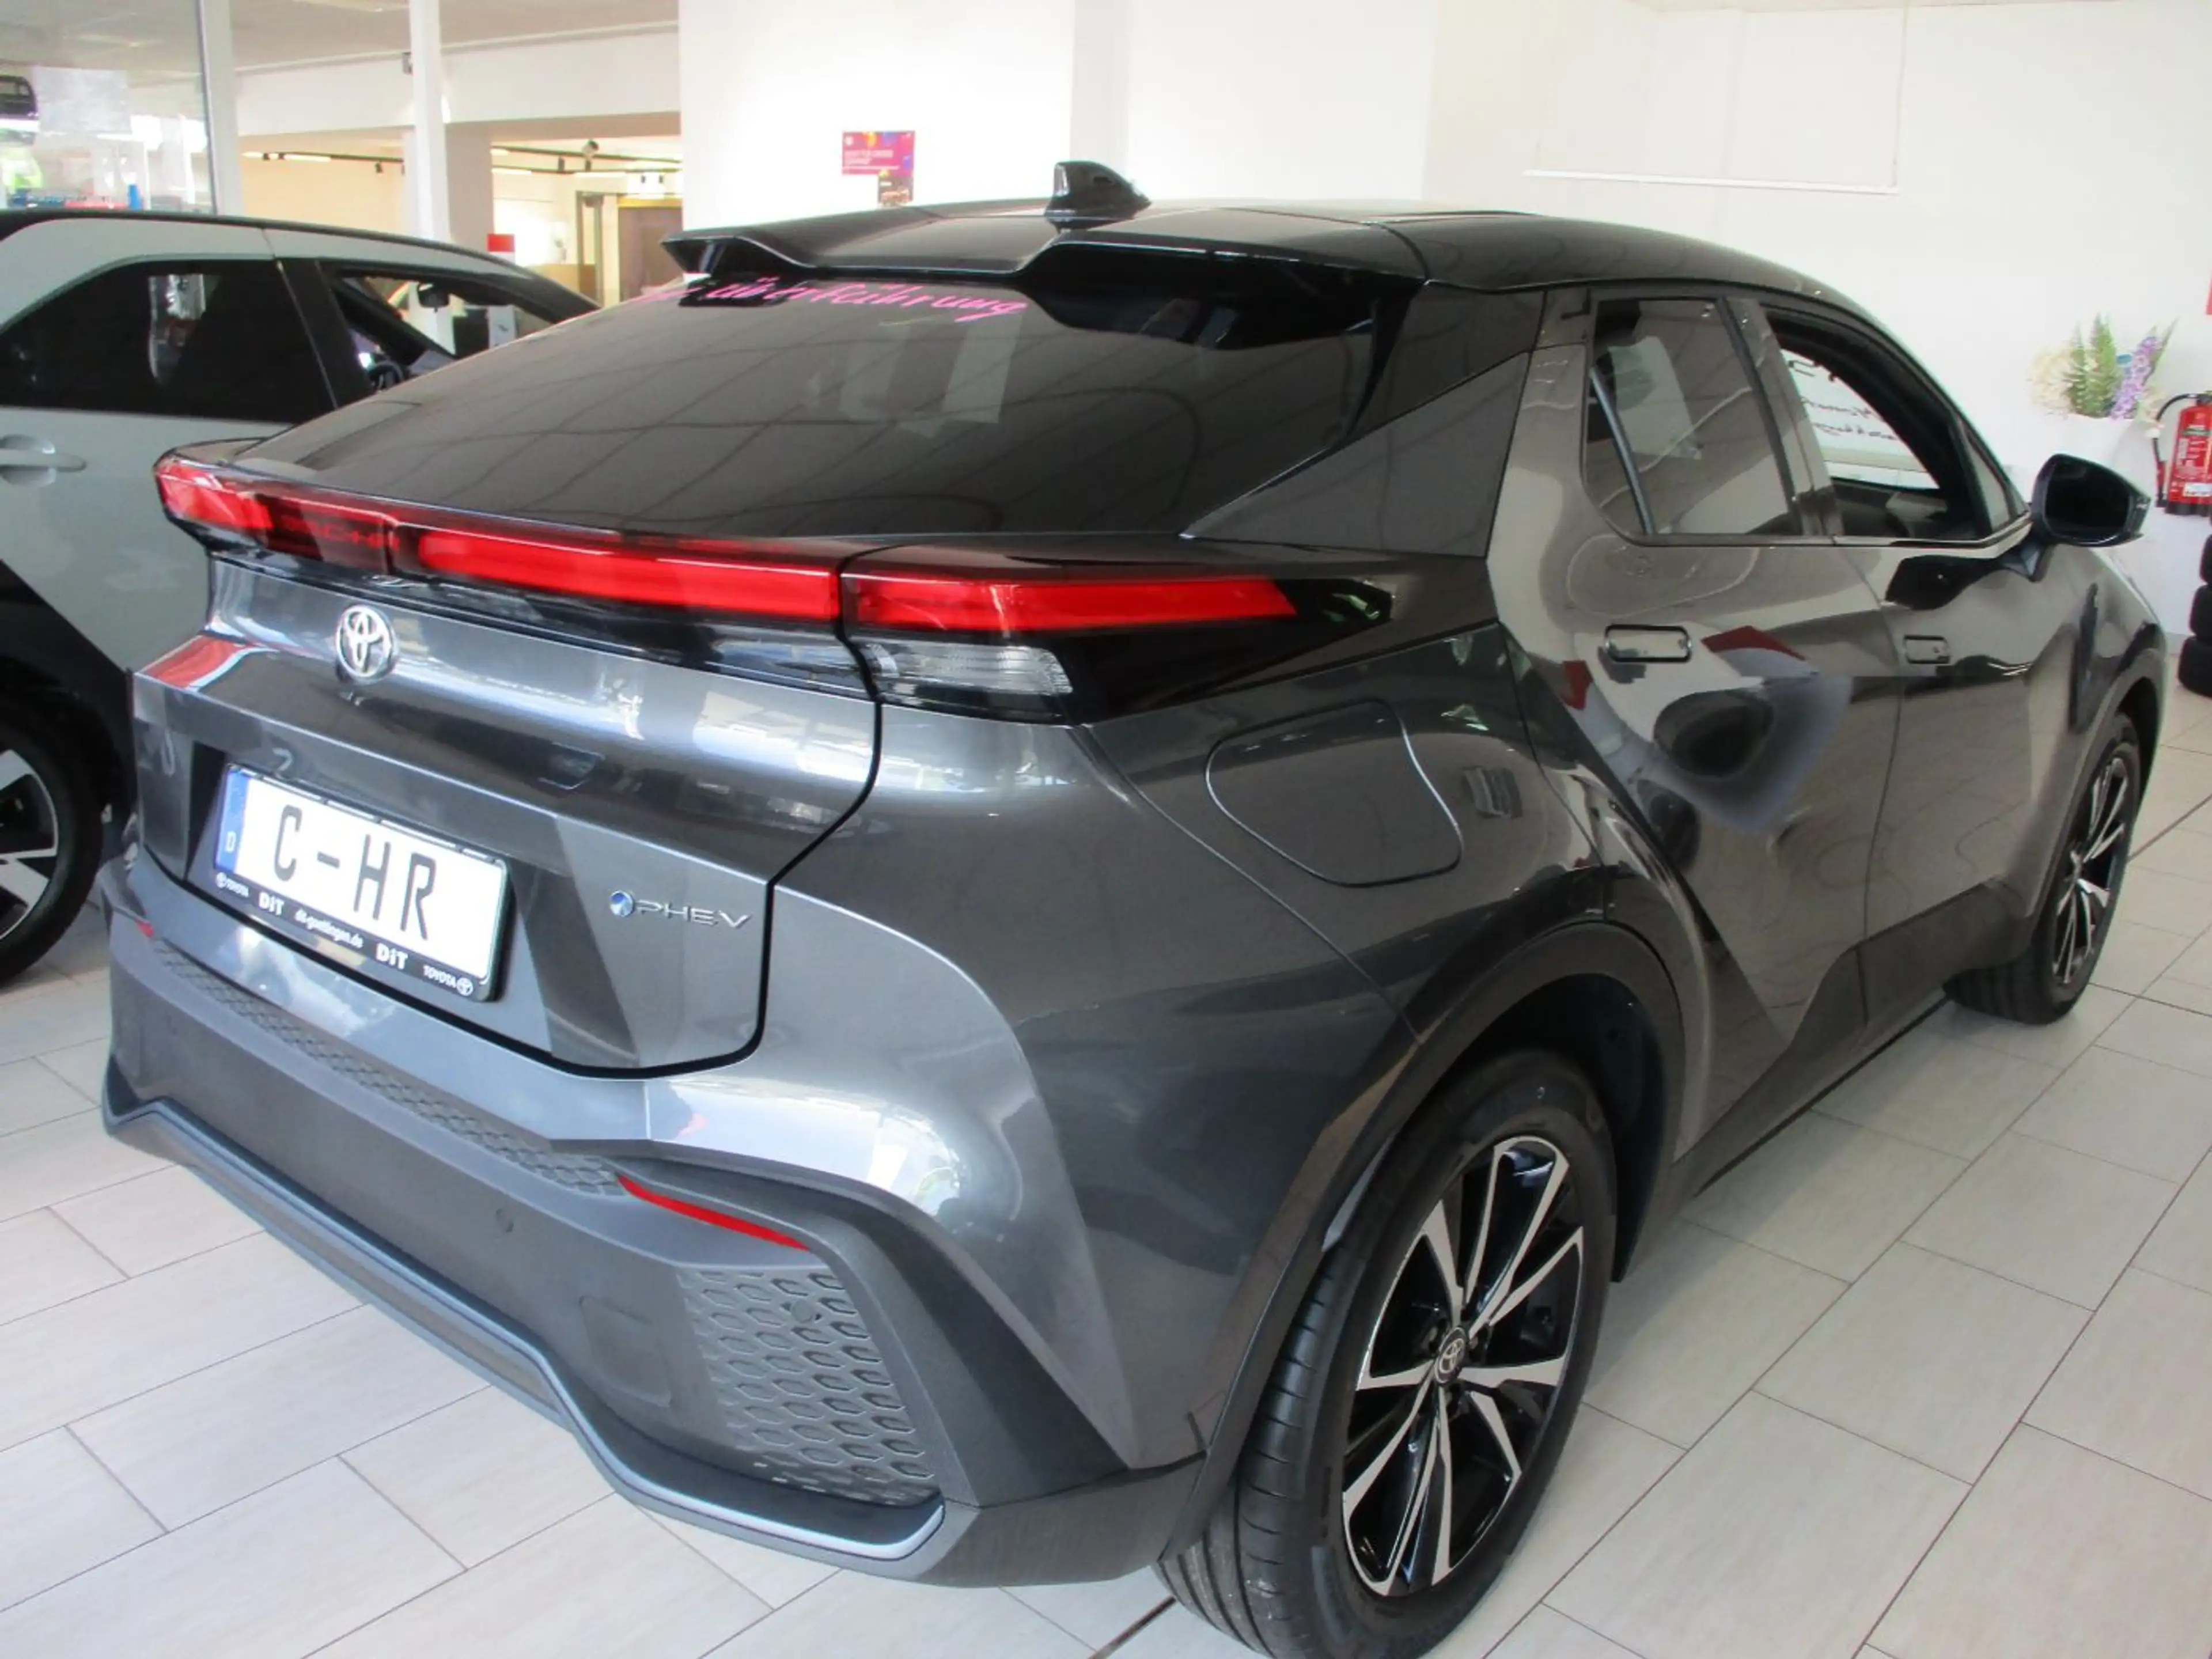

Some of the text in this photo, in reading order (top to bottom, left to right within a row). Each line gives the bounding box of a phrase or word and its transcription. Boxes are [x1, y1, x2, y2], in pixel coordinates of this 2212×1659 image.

[226, 832, 237, 852] D
[274, 804, 437, 941] C-HR
[635, 898, 750, 929] PHEV
[423, 964, 457, 989] TOYOTA
